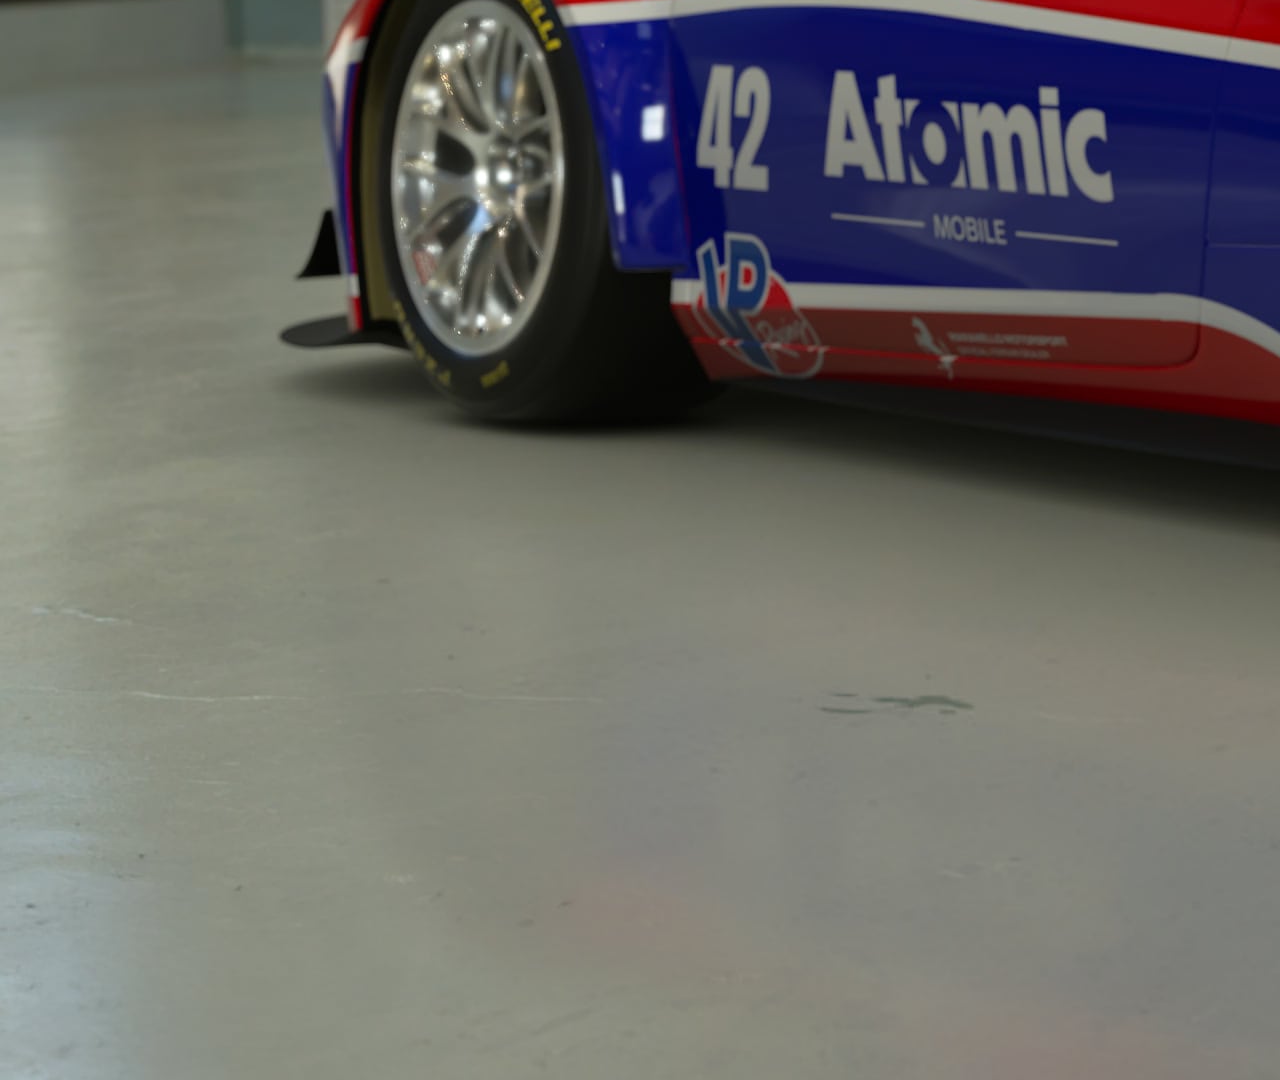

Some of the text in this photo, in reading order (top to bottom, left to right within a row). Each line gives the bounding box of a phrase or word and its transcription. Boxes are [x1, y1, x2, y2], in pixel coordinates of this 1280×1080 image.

[696, 65, 771, 192] 42
[824, 69, 1114, 202] Atomic
[933, 214, 1007, 245] MOBILE
